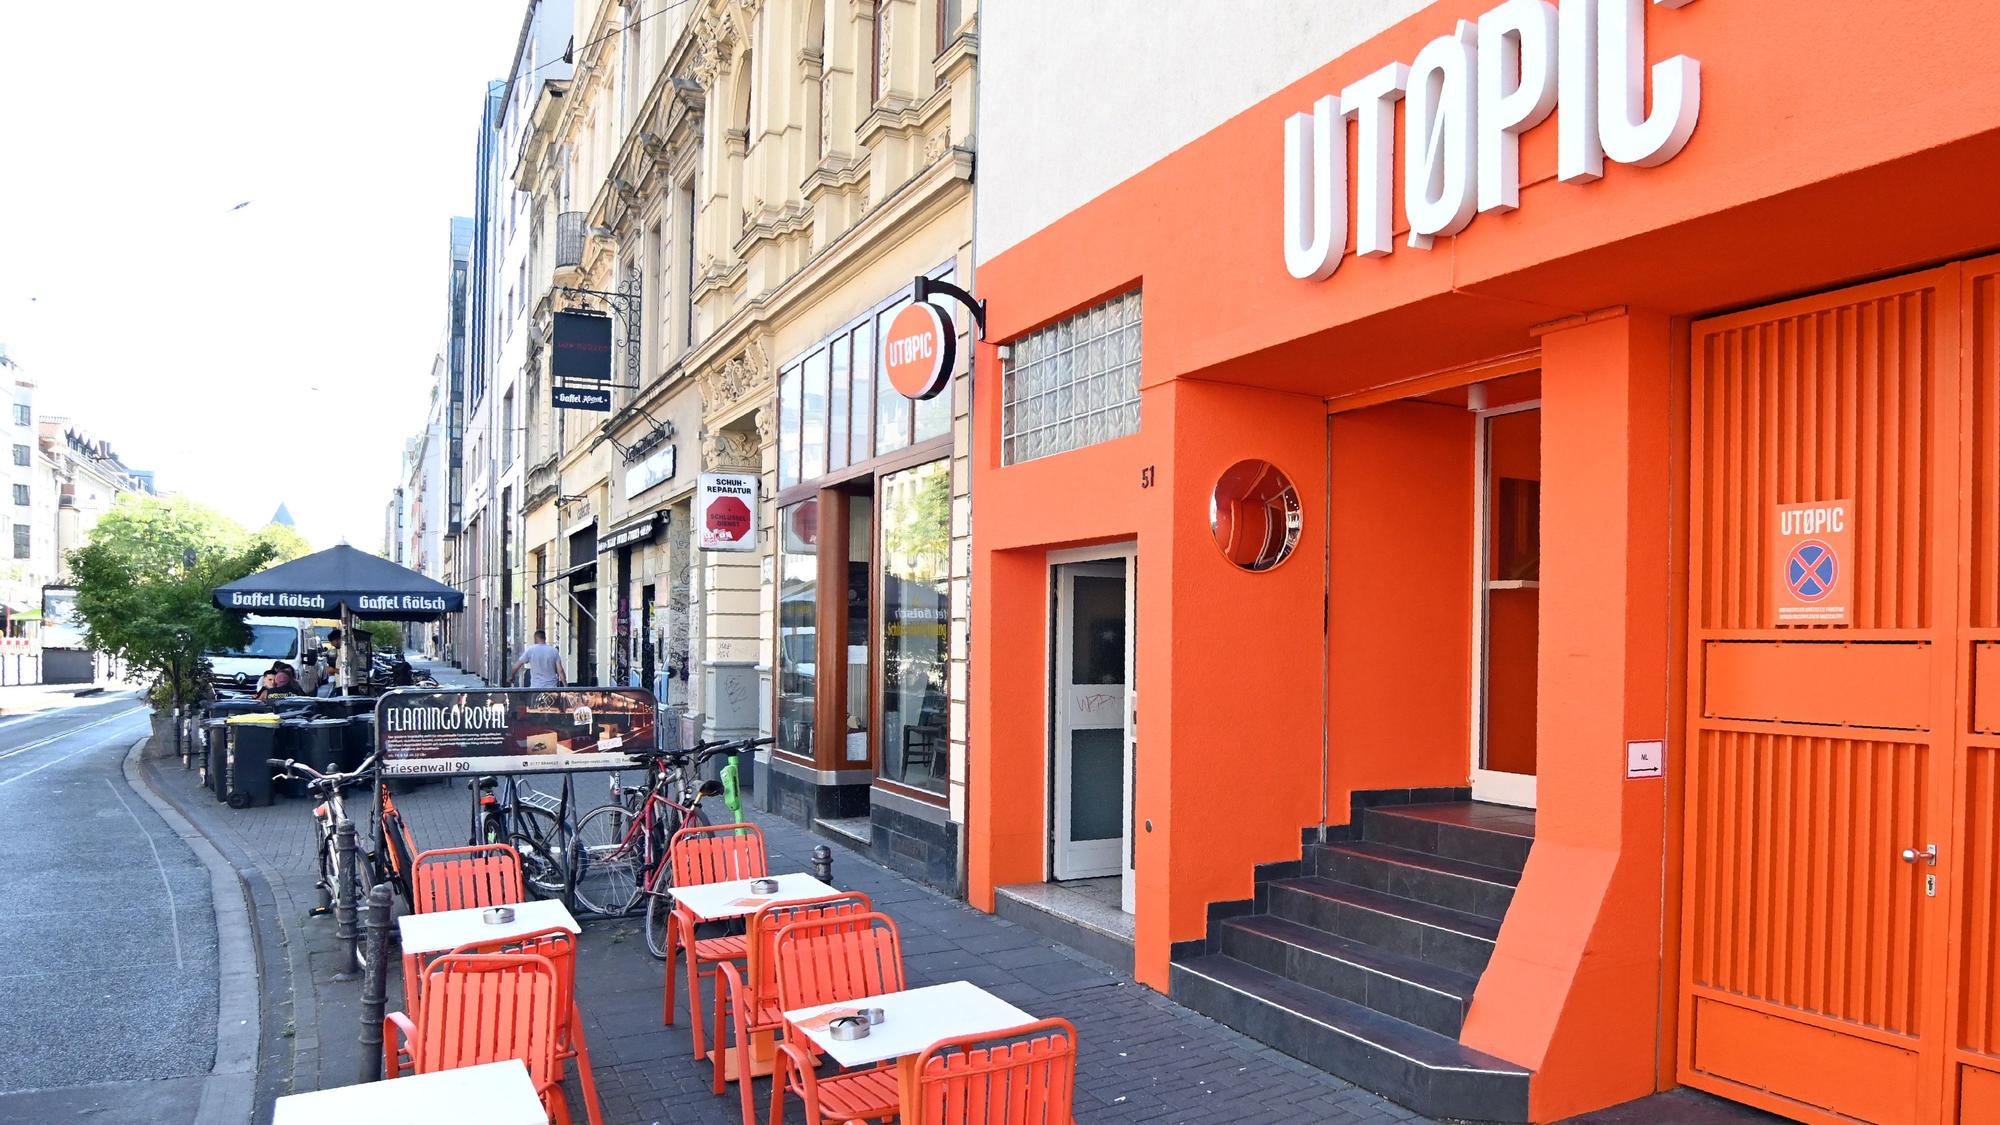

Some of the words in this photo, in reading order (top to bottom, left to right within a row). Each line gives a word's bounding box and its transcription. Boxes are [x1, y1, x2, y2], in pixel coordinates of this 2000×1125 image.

[1284, 0, 1701, 281] UTØPIC
[890, 332, 932, 368] UTØPIC
[1142, 465, 1155, 489] 51
[707, 486, 751, 494] REPARATUR
[1781, 507, 1844, 536] UTØPIC
[232, 592, 275, 607] Gaffel
[279, 592, 325, 609] Kölsch
[359, 596, 399, 610] Gaffel
[402, 596, 446, 611] Kölsch
[387, 704, 461, 731] FLAMINGO
[465, 706, 509, 729] ROYAL
[384, 762, 453, 774] Friesenwall
[455, 762, 470, 772] 90
